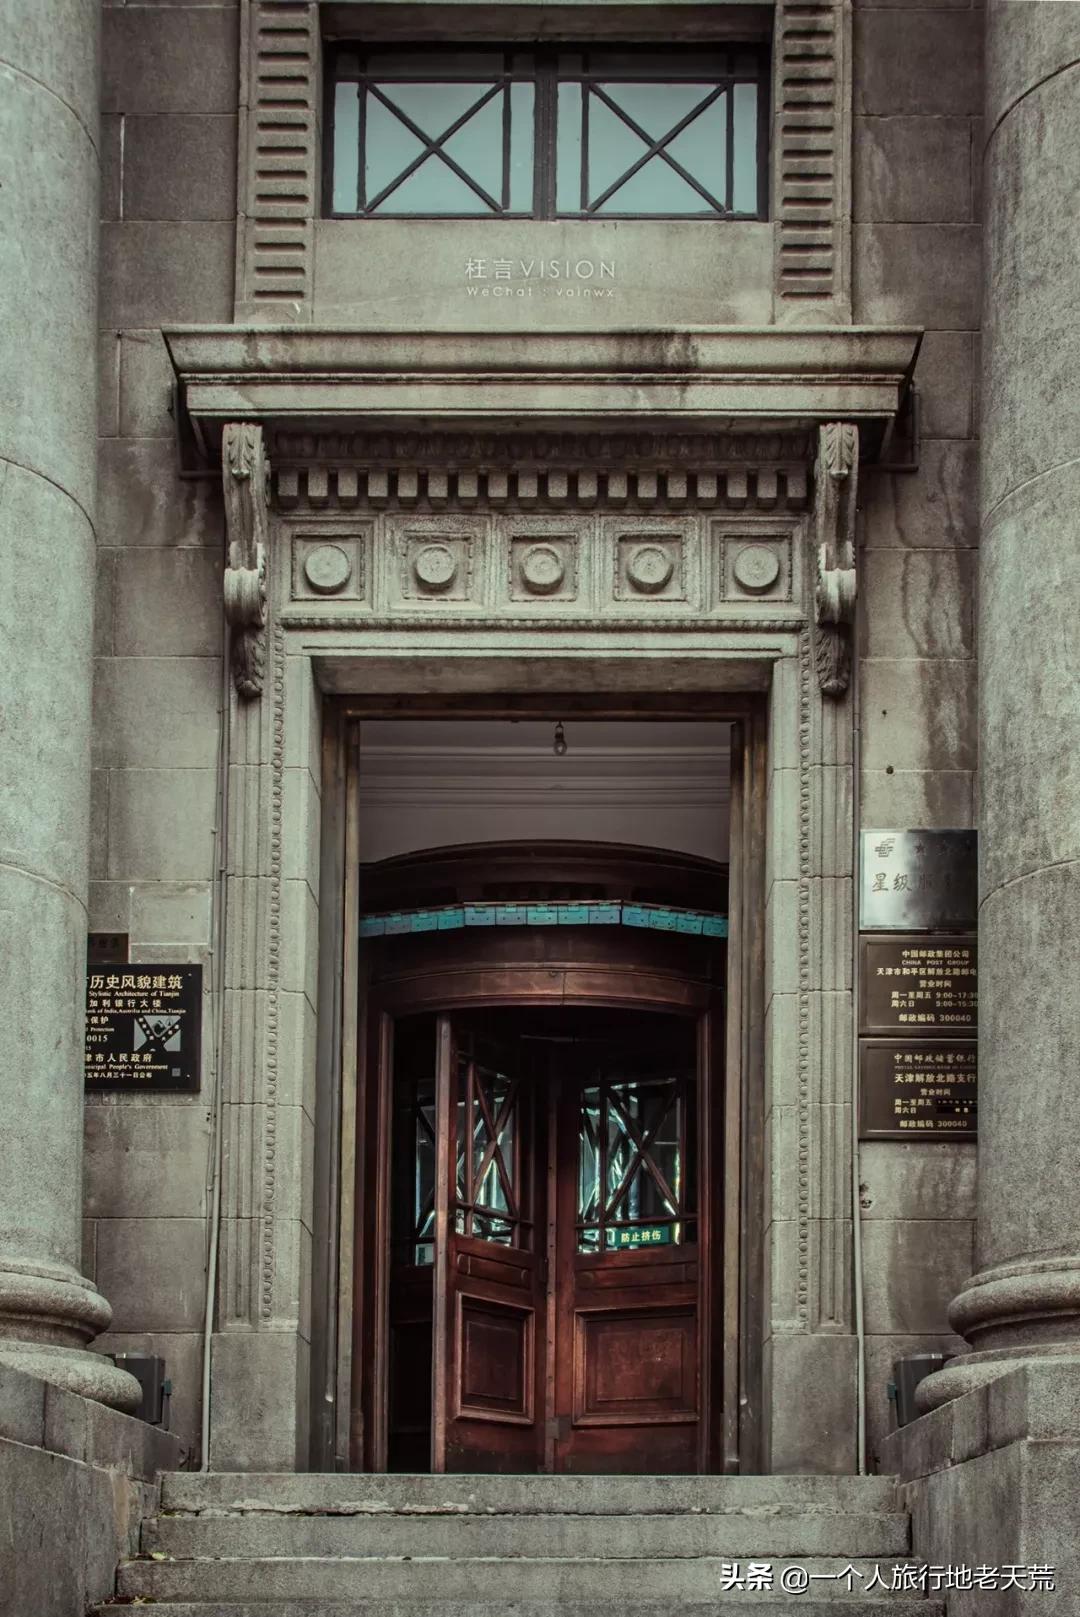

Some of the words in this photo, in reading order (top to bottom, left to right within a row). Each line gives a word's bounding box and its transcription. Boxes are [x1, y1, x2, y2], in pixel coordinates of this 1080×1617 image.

[901, 950, 969, 958] 中国邮政集团公司
[86, 974, 183, 989] 历史风貌建筑
[919, 980, 952, 988] 营业时间
[898, 1013, 936, 1022] 邮政编码
[939, 1014, 972, 1022] 300040
[621, 1230, 661, 1243] 防止挤伤
